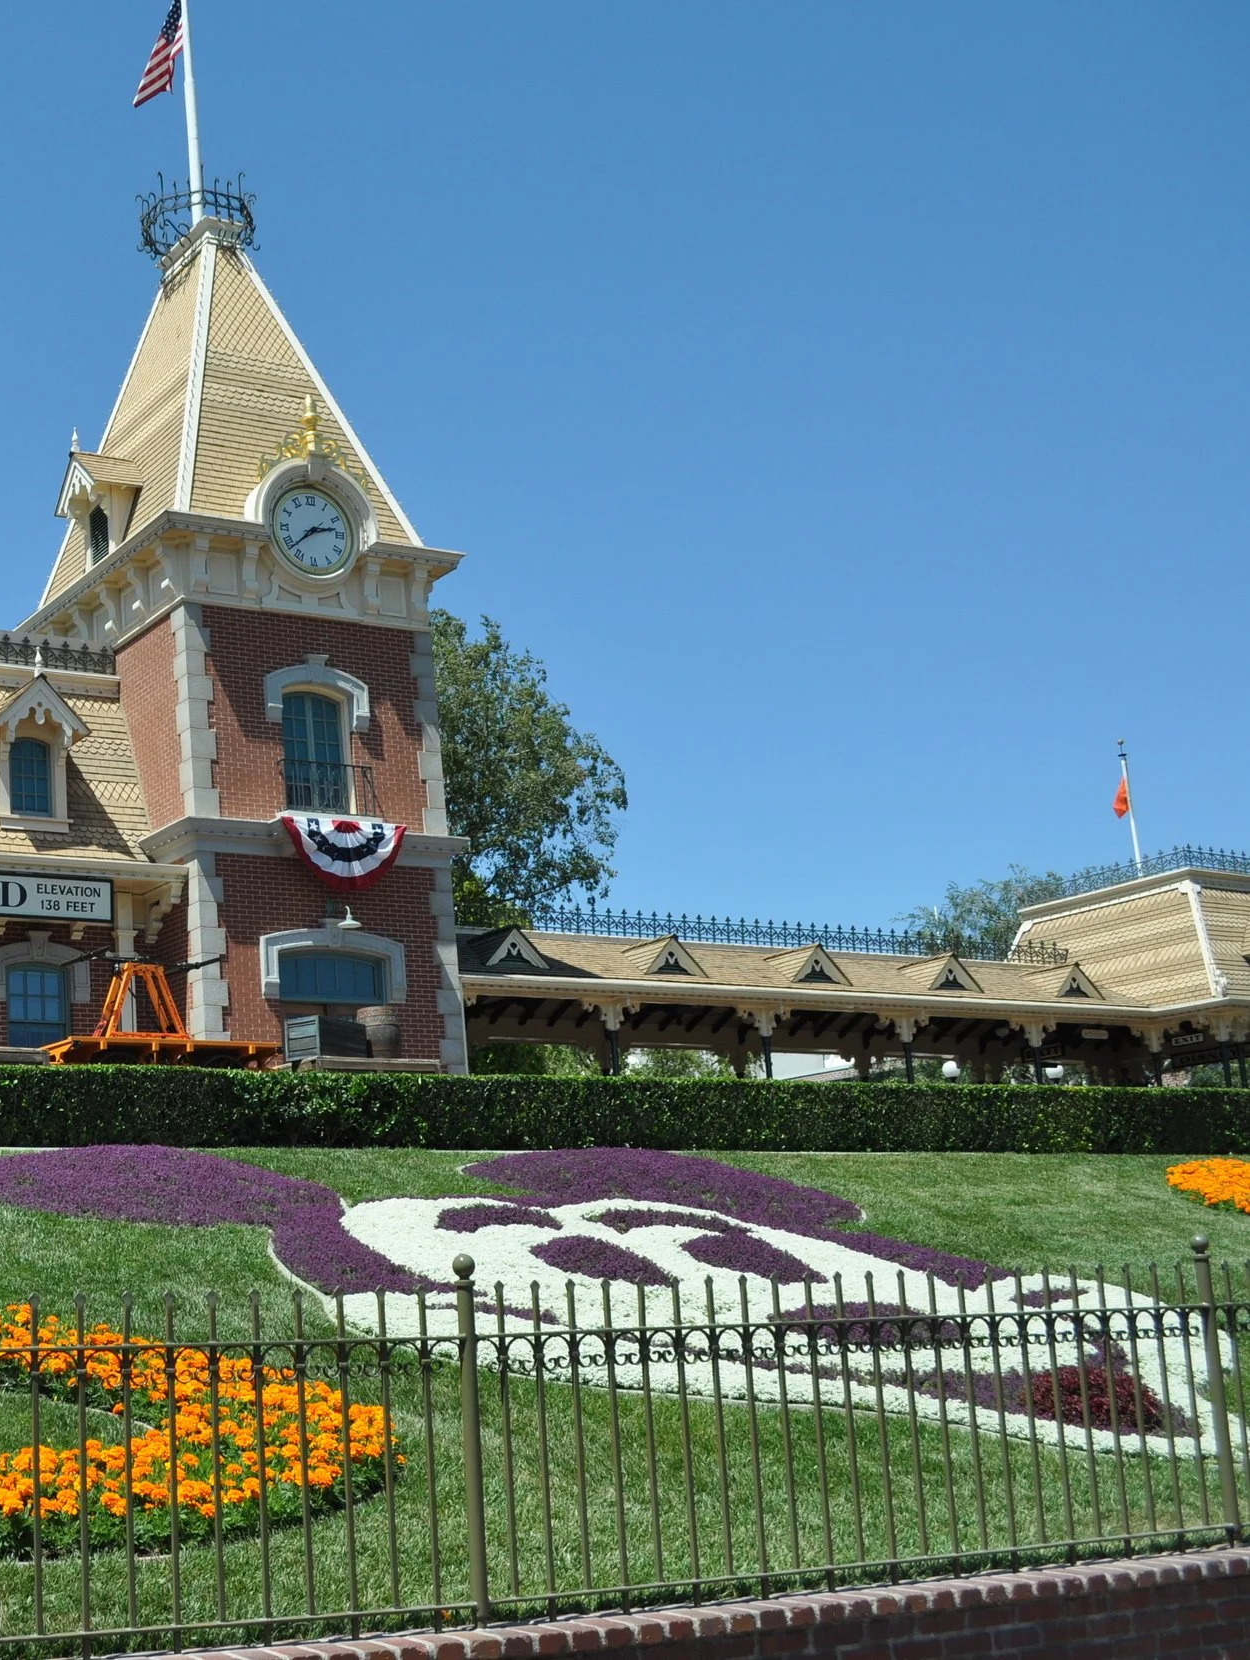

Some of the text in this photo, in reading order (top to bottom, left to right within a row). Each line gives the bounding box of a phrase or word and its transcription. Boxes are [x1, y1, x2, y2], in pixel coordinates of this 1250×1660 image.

[36, 883, 101, 898] ELEVATION
[40, 899, 96, 913] 138 FEET
[1174, 1035, 1200, 1045] EXIT
